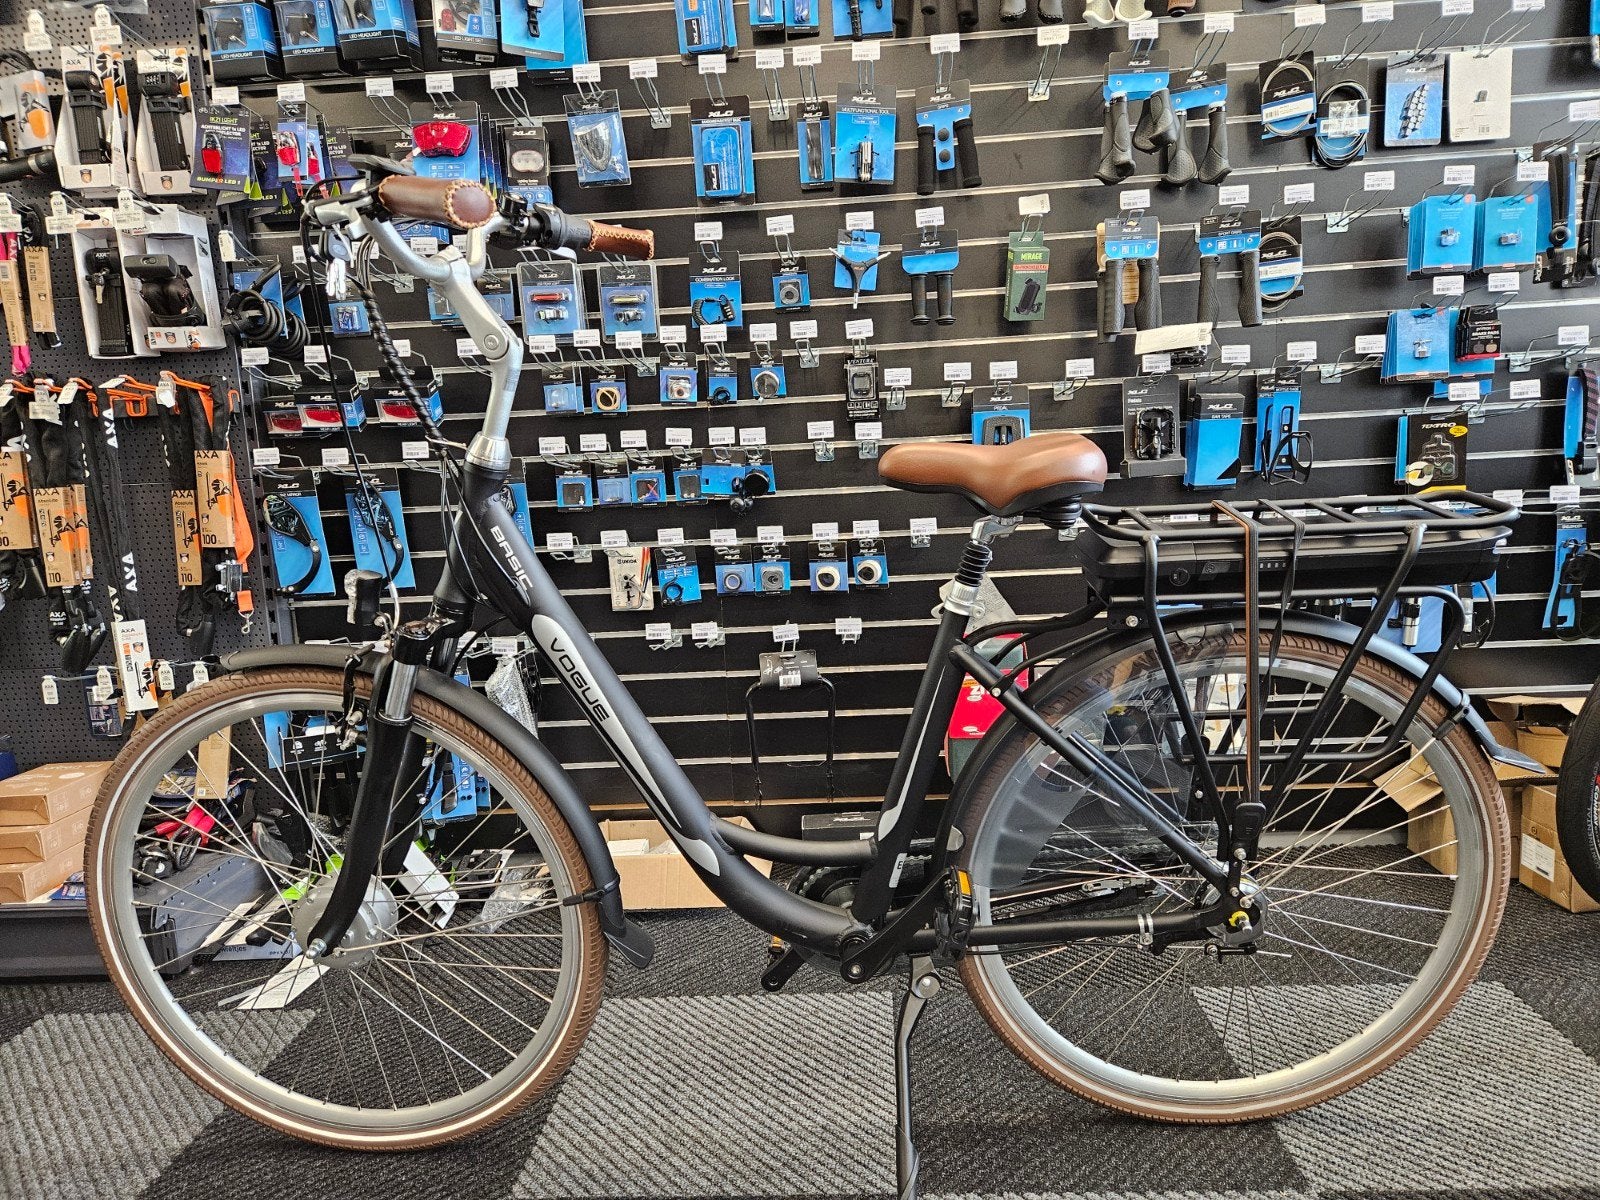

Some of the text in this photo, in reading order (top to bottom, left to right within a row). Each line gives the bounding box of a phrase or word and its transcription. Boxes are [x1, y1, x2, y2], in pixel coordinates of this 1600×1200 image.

[201, 124, 232, 132] ACHTERLICHT
[197, 176, 224, 185] BUMPER
[25, 245, 44, 253] AXA
[1020, 252, 1043, 261] MIRAGE
[102, 408, 118, 448] AXA
[1421, 422, 1456, 430] TEKTRO
[196, 450, 219, 459] AXA
[35, 488, 60, 497] AXA
[171, 490, 194, 499] AXA
[202, 534, 217, 545] 100
[490, 525, 533, 592] BASIC
[122, 551, 138, 592] AXA
[48, 572, 61, 583] 110
[181, 573, 193, 583] 110
[550, 637, 610, 722] VOGUE
